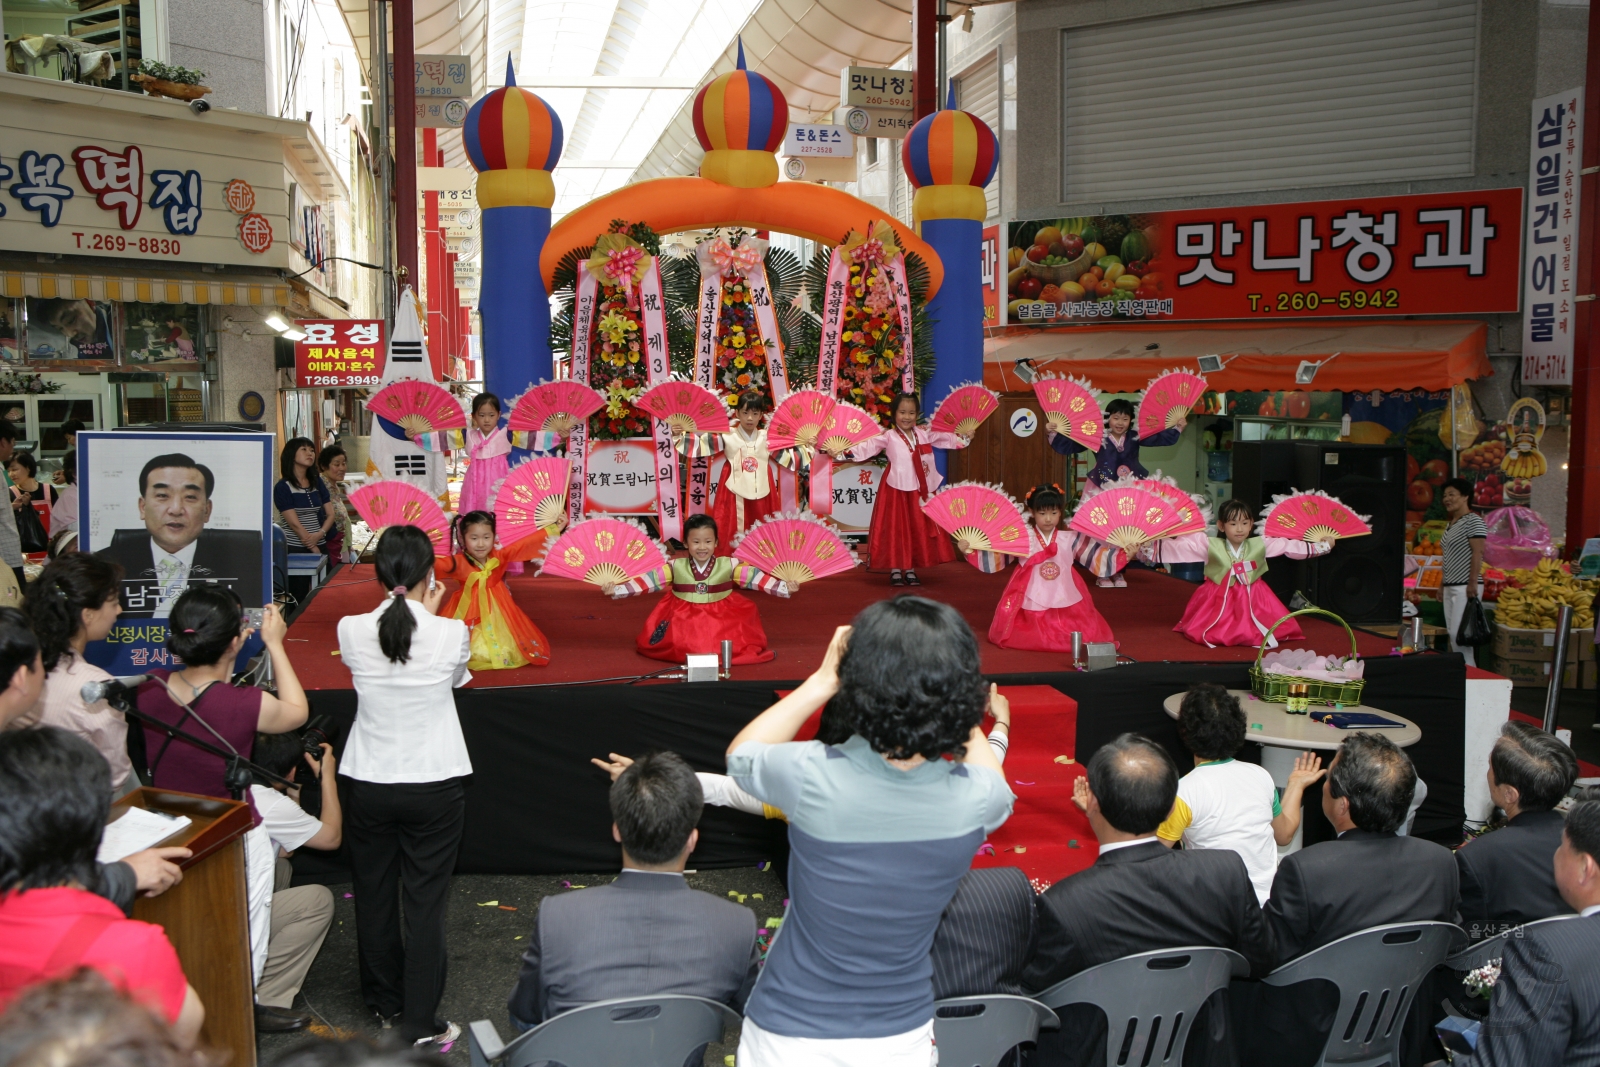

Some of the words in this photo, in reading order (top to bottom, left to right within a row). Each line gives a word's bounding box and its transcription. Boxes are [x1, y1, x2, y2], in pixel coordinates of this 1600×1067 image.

[852, 74, 912, 93] 맛나청
[866, 96, 910, 107] 260-5942
[795, 128, 842, 143] 돈&돈스
[800, 146, 833, 154] 227-2528
[0, 145, 202, 236] 복떡집
[1531, 103, 1566, 343] 삼일건어물
[72, 232, 182, 257] T.269-8830
[1177, 206, 1496, 286] 맛나청과
[644, 293, 661, 311] 祝
[753, 287, 770, 307] 祝
[826, 280, 845, 326] 울산광역시
[1017, 303, 1057, 319] 얼음골
[1060, 301, 1114, 317] 사과농장
[1118, 299, 1174, 316] 직영판매
[702, 285, 718, 356] 울산광역시
[302, 323, 380, 345] 효성
[307, 347, 375, 360] 제사음식
[1524, 354, 1567, 381] 274-5714
[614, 450, 630, 464] 祝
[857, 469, 874, 486] 祝
[832, 487, 879, 505] 祝賀합
[661, 497, 678, 519] 날
